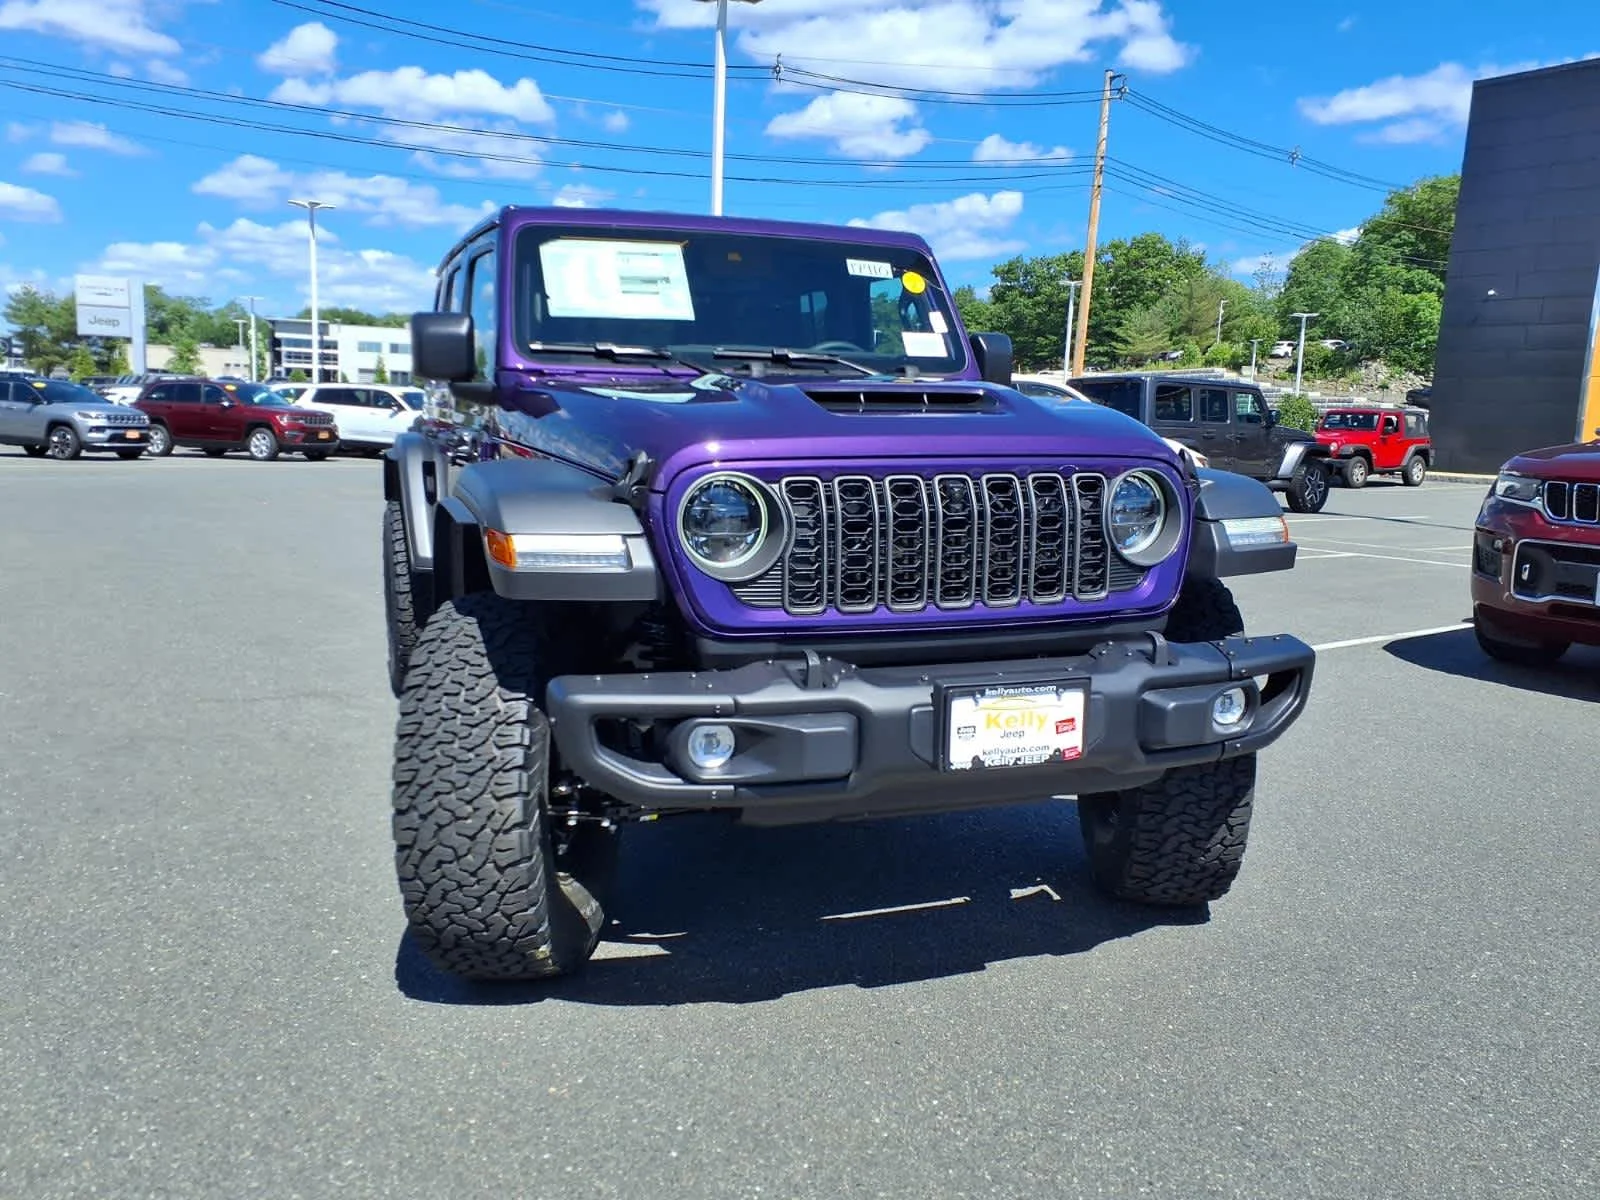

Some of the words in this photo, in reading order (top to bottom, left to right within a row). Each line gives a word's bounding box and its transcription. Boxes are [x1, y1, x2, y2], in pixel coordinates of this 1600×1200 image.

[88, 315, 121, 328] Jeep
[985, 684, 1057, 697] kellyauto.com
[985, 711, 1049, 730] Kelly
[1000, 729, 1025, 739] Jeep
[982, 744, 1050, 757] kellyauto.com
[984, 754, 1015, 767] Kelly
[1016, 753, 1050, 764] JEEP
